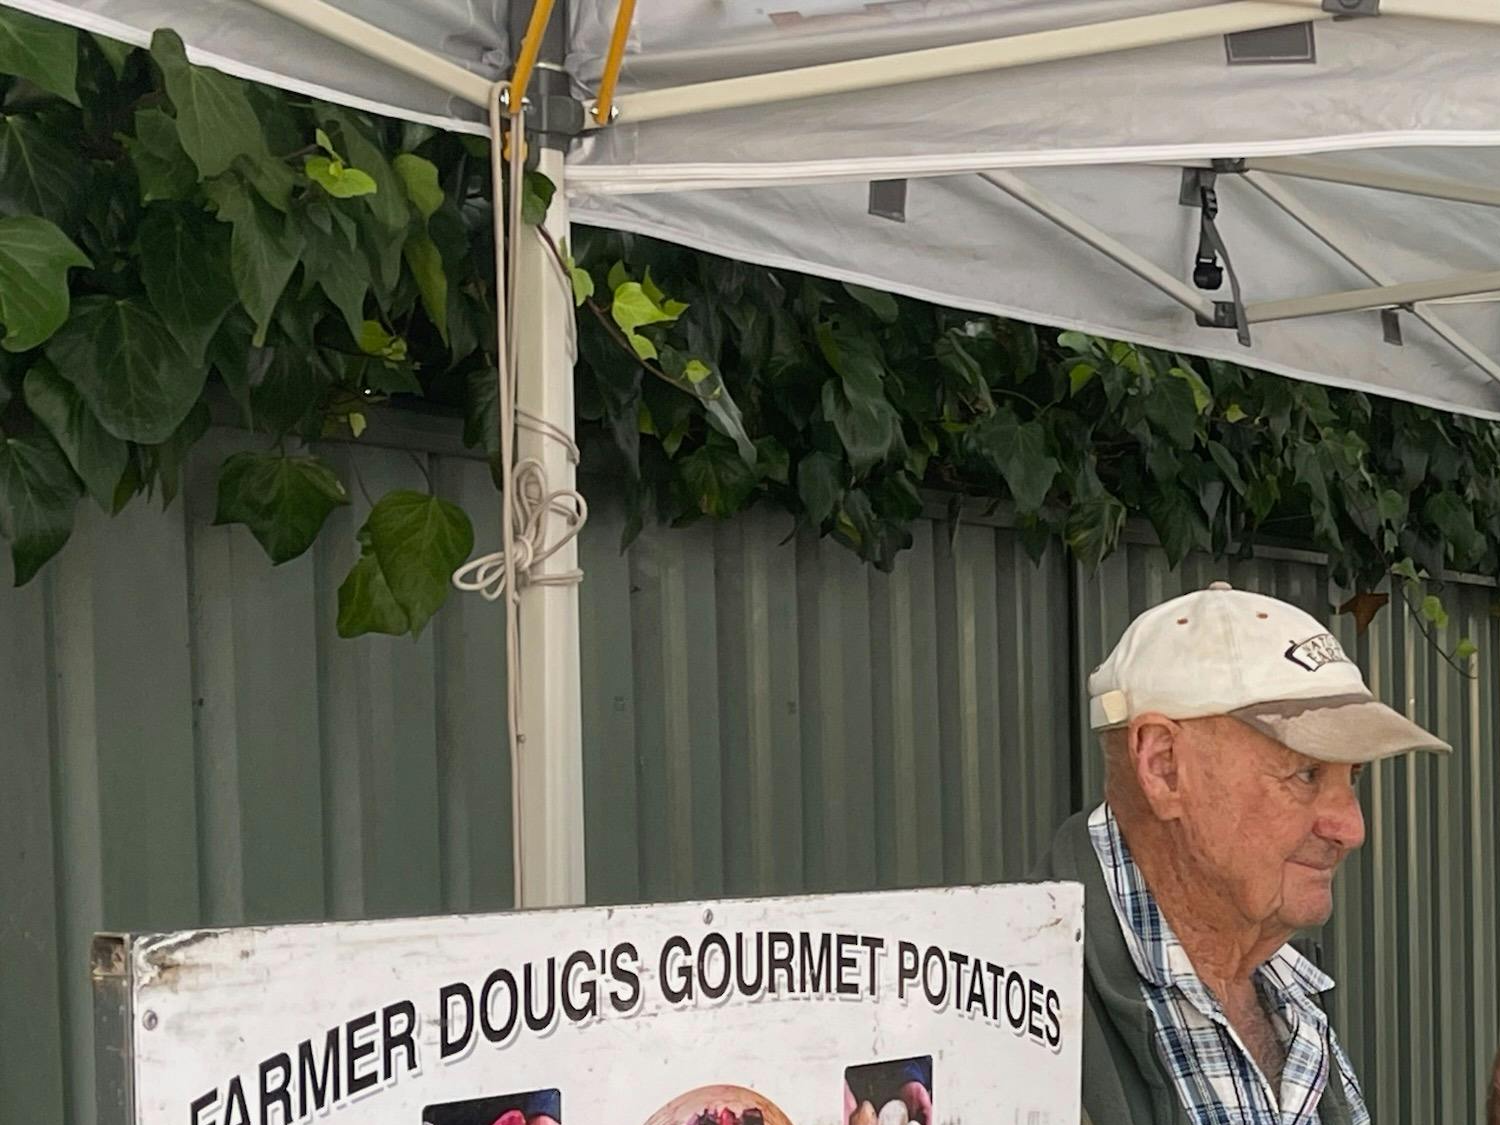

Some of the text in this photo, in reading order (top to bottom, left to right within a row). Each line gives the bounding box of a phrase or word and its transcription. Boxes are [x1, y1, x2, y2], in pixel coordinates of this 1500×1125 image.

[439, 941, 641, 1058] DOUG'S
[659, 931, 885, 1003] GOURMET
[898, 939, 1062, 1047] POTATOES
